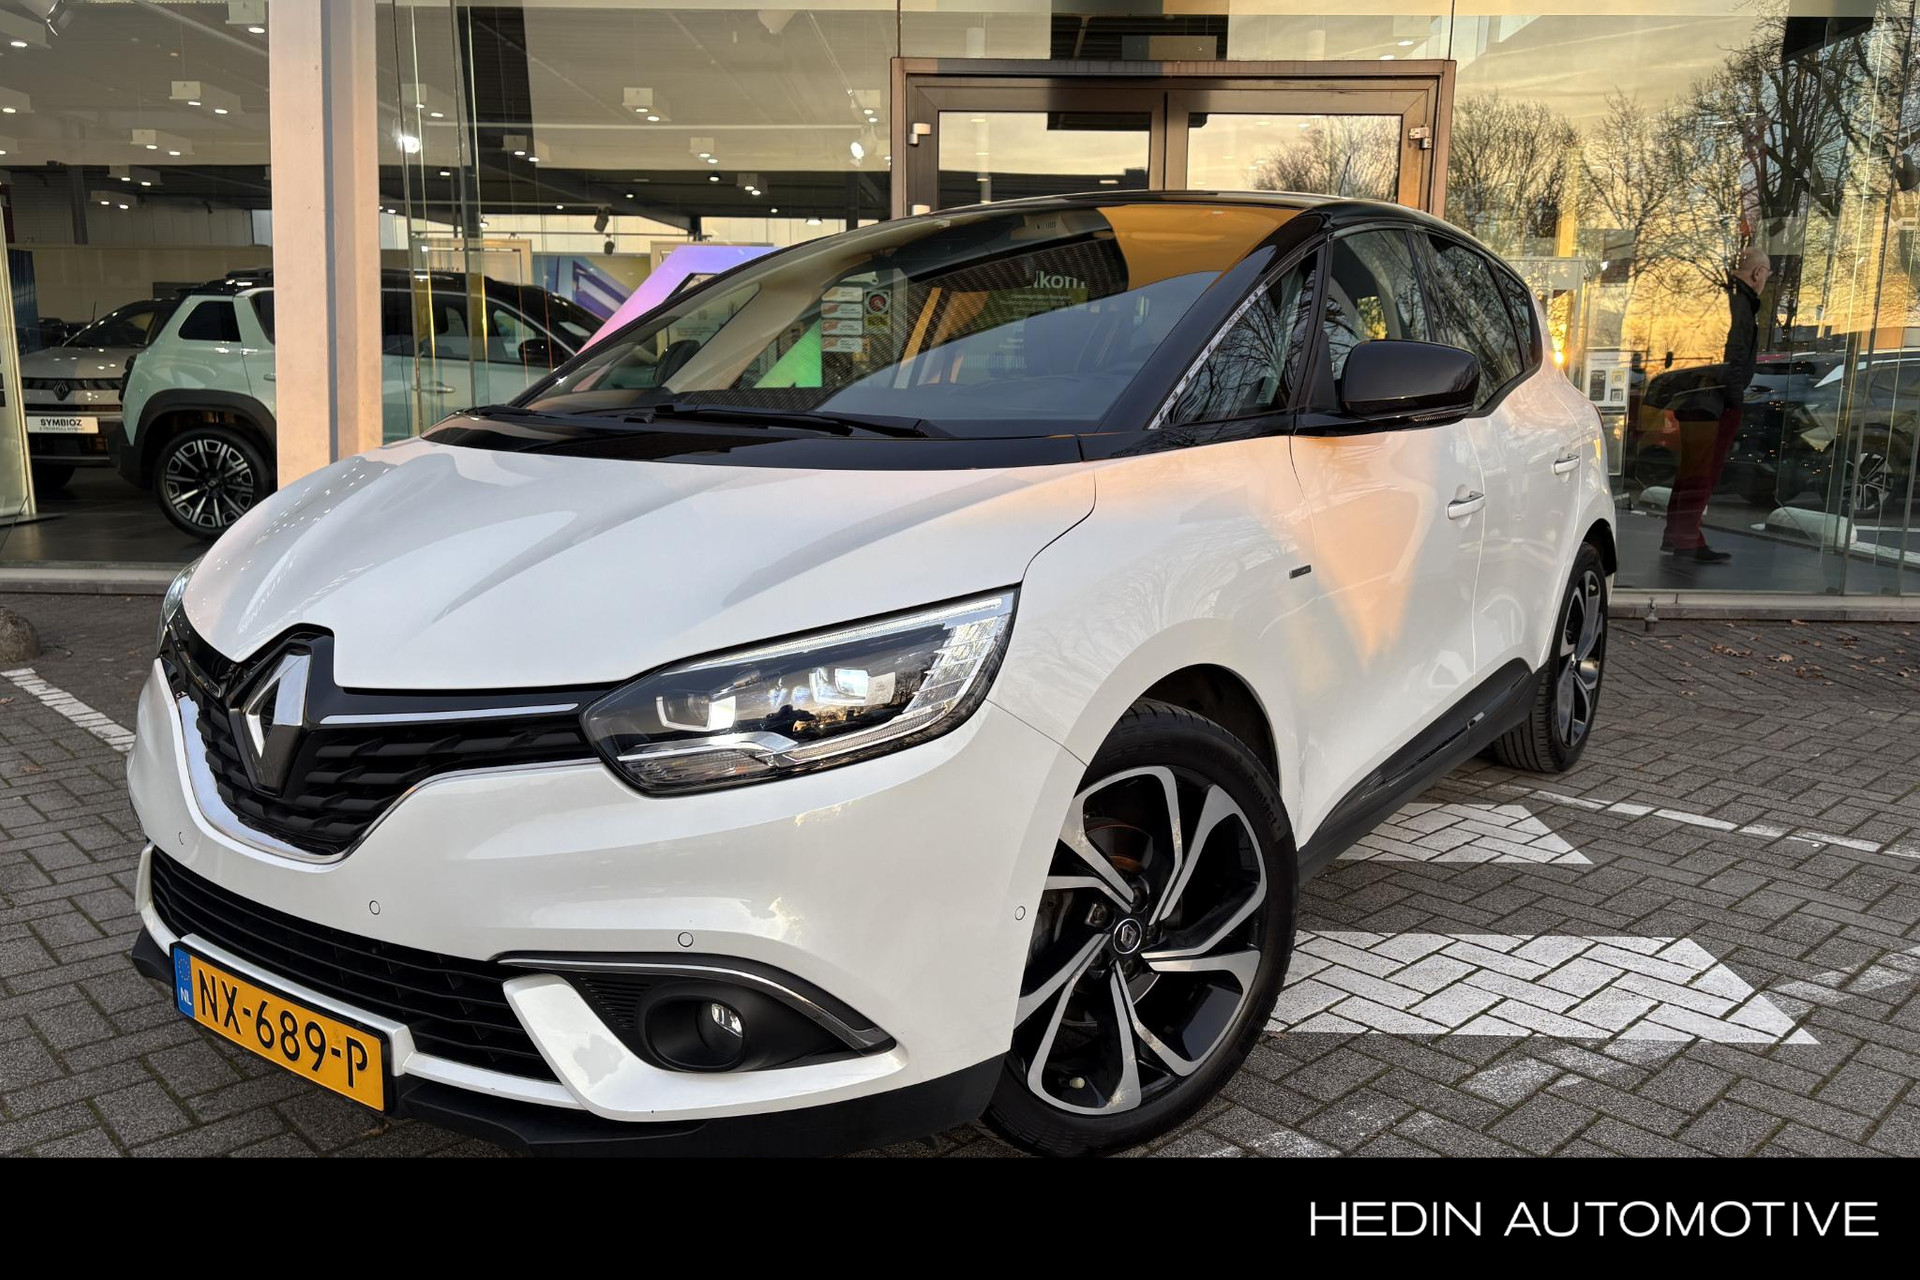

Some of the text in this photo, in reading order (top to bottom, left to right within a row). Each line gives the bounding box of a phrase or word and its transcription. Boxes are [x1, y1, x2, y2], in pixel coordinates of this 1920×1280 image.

[40, 418, 83, 427] SYMBIOZ
[179, 987, 193, 1006] NL
[198, 968, 368, 1088] NX-689-P
